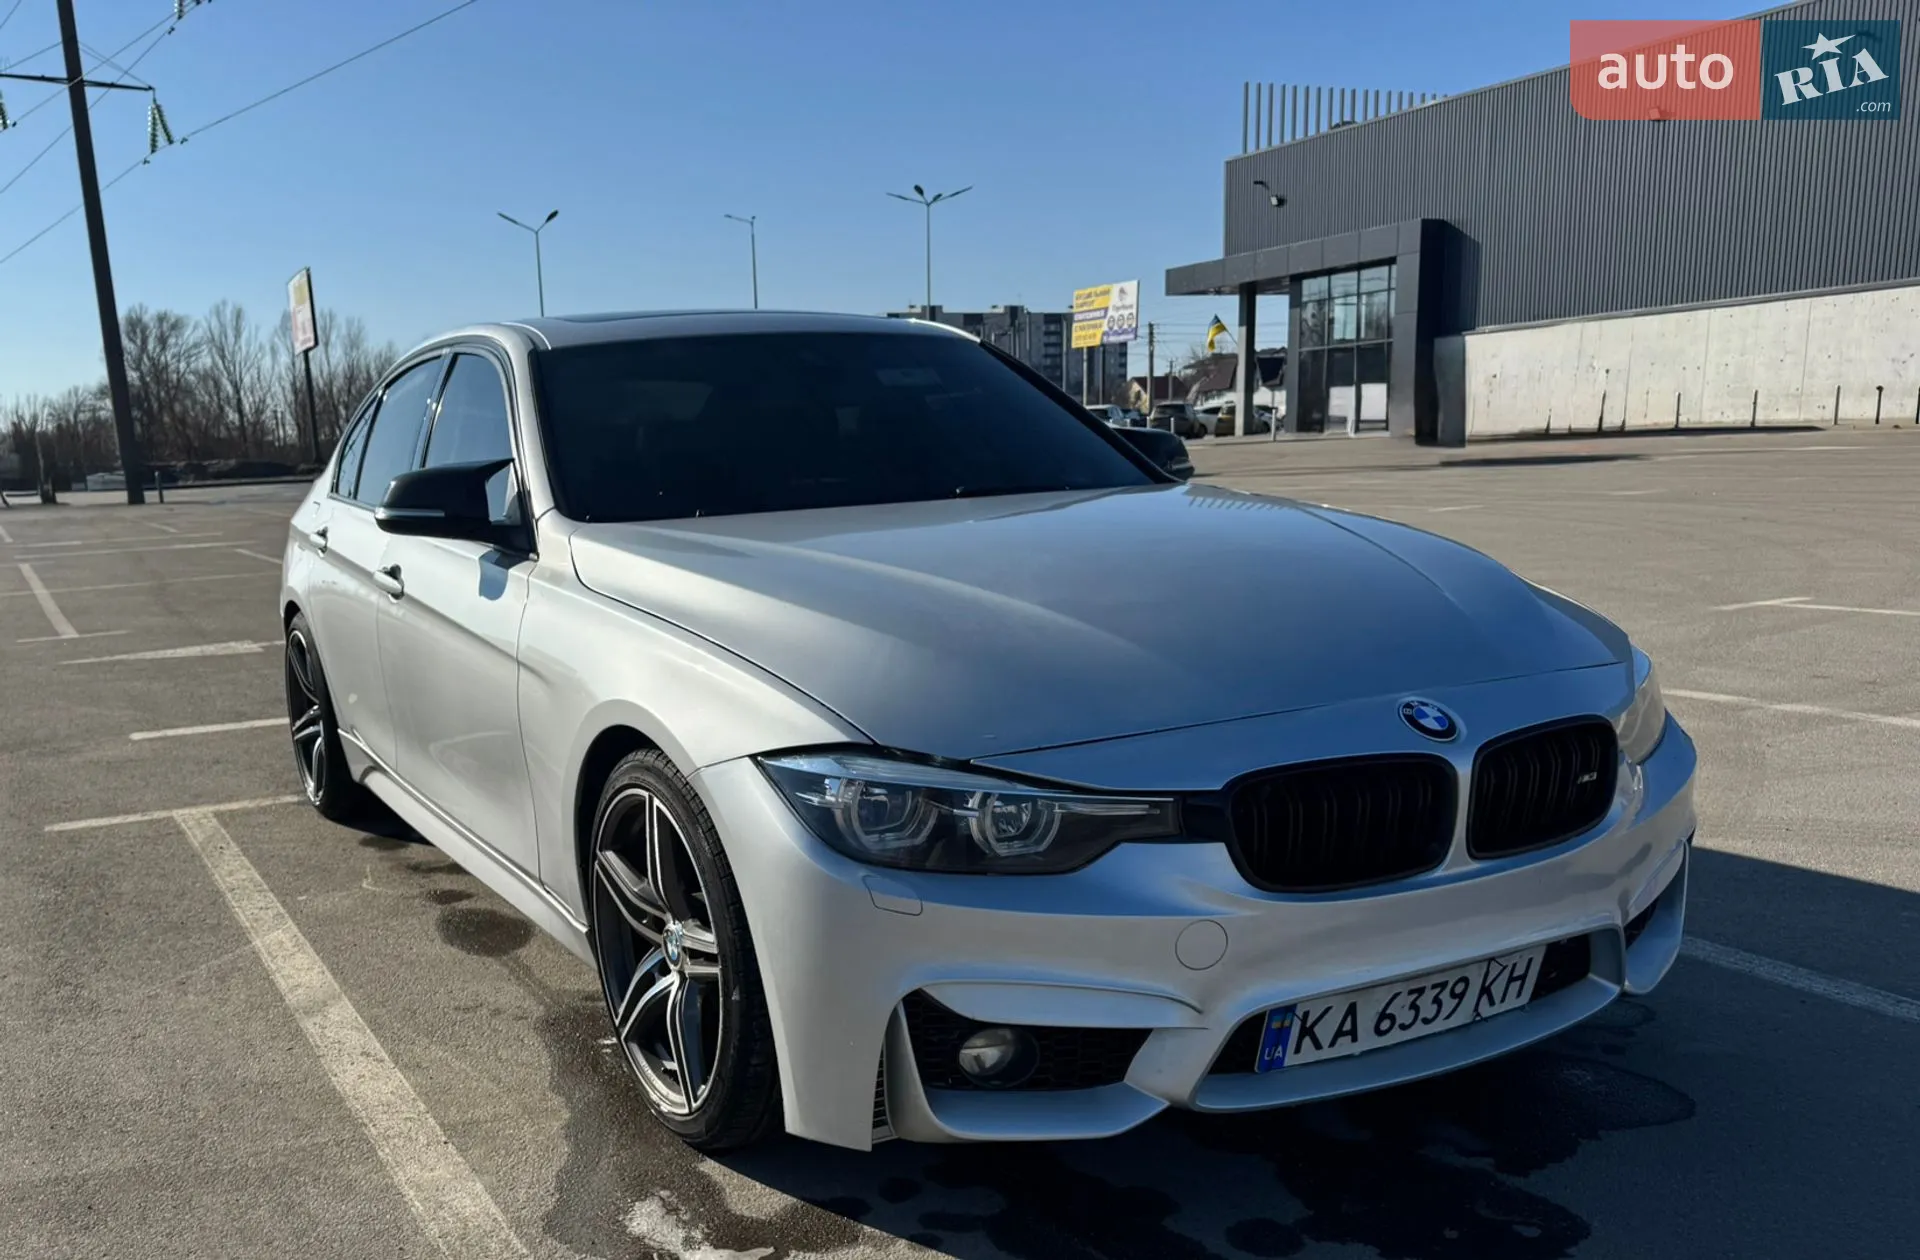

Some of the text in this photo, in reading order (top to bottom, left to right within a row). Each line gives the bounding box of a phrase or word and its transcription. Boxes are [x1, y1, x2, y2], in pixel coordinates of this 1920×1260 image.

[1293, 957, 1534, 1055] KA 6339 KH
[1264, 1045, 1283, 1060] UA
